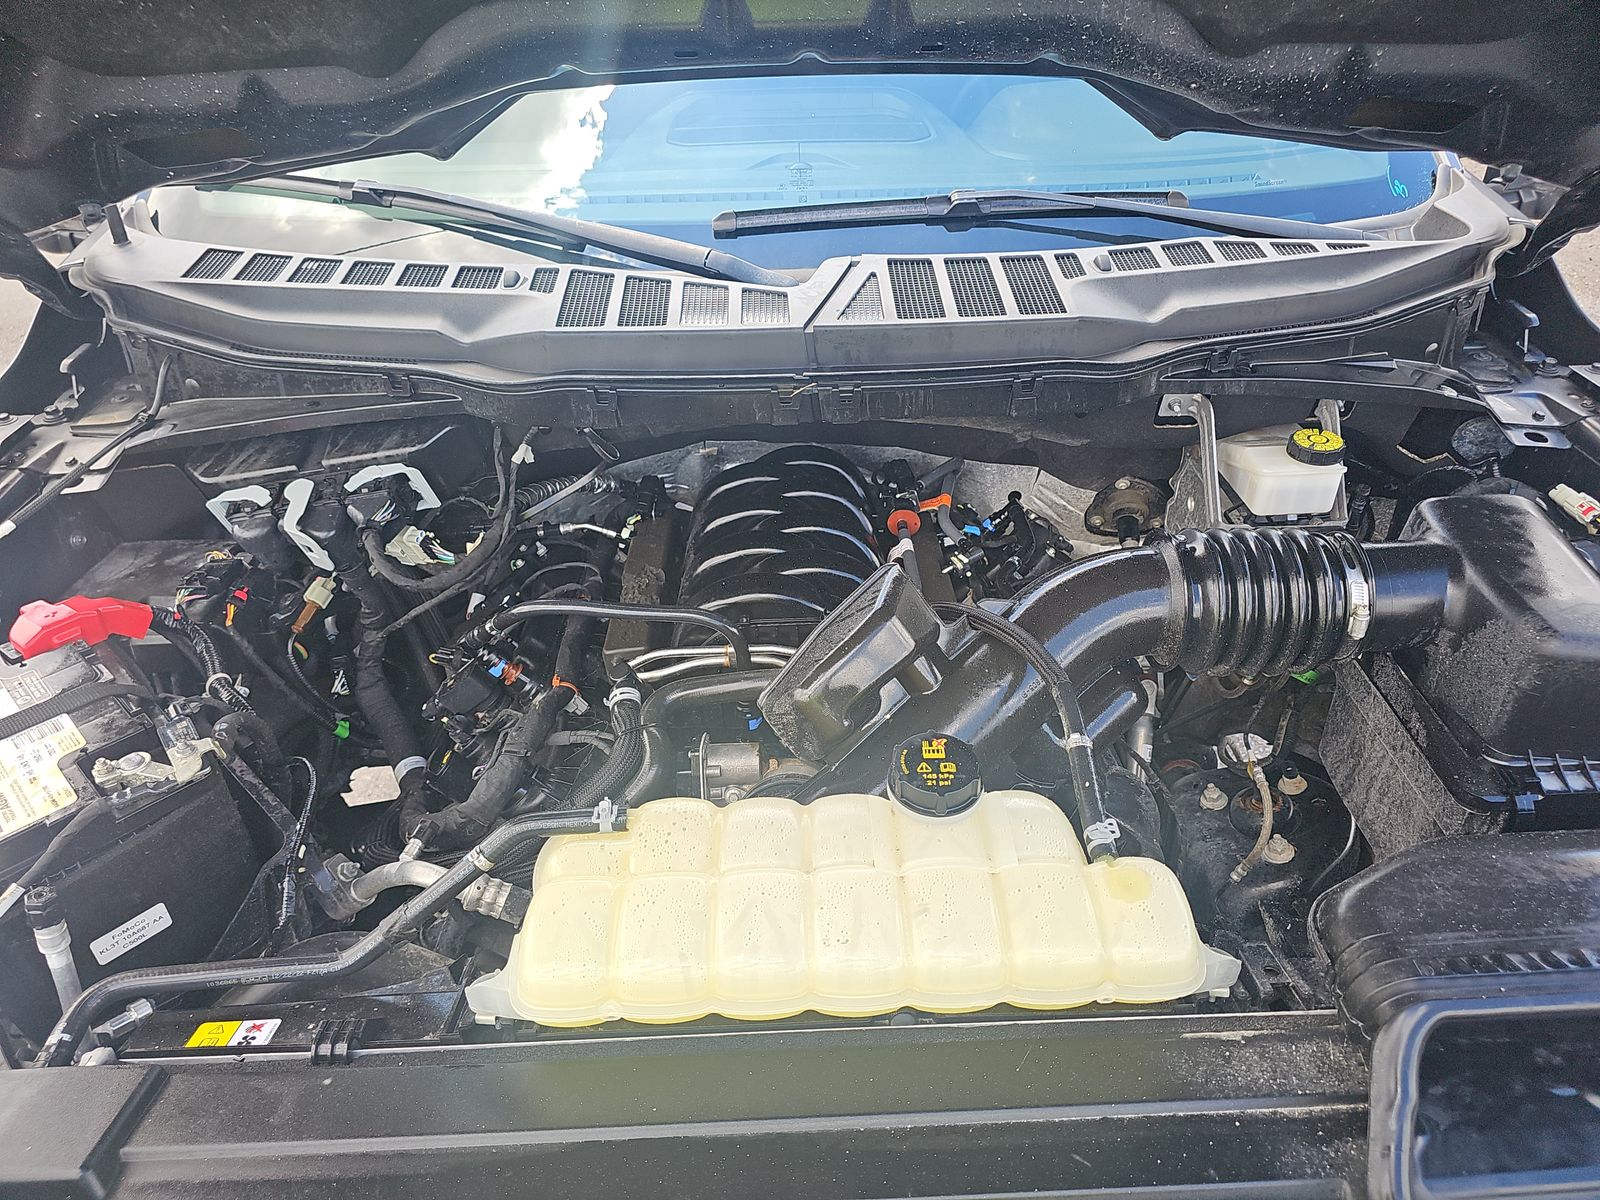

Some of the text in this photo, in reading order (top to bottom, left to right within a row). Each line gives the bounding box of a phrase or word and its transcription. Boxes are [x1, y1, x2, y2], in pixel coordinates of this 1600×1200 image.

[99, 940, 120, 955] KL3T
[152, 915, 164, 924] AA
[111, 918, 146, 940] FoMoCo
[122, 933, 148, 949] C500L
